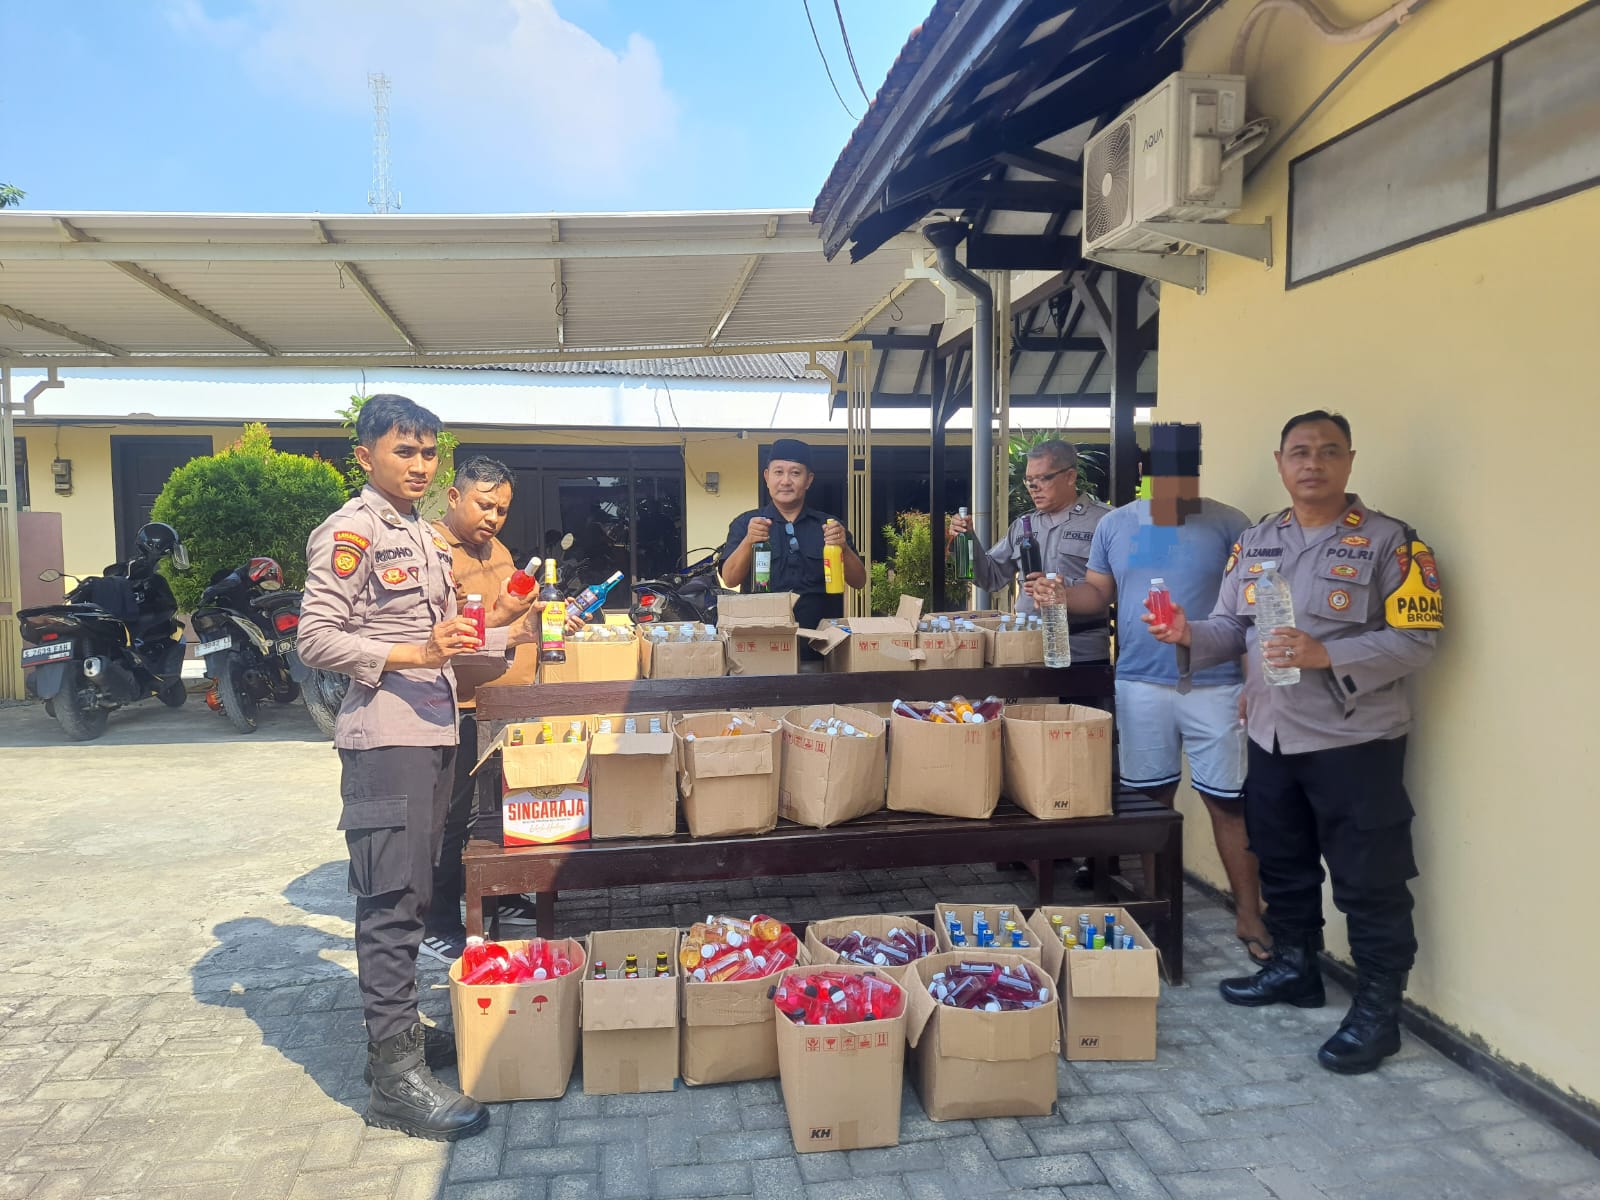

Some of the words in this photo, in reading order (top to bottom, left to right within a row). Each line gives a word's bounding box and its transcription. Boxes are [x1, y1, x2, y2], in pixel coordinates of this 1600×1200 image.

[1142, 128, 1164, 152] AQUA
[1326, 548, 1373, 560] POLRI
[508, 798, 585, 821] SINGARAJA
[1054, 800, 1069, 808] KH
[1081, 1037, 1098, 1046] KH
[811, 1128, 831, 1139] KH
